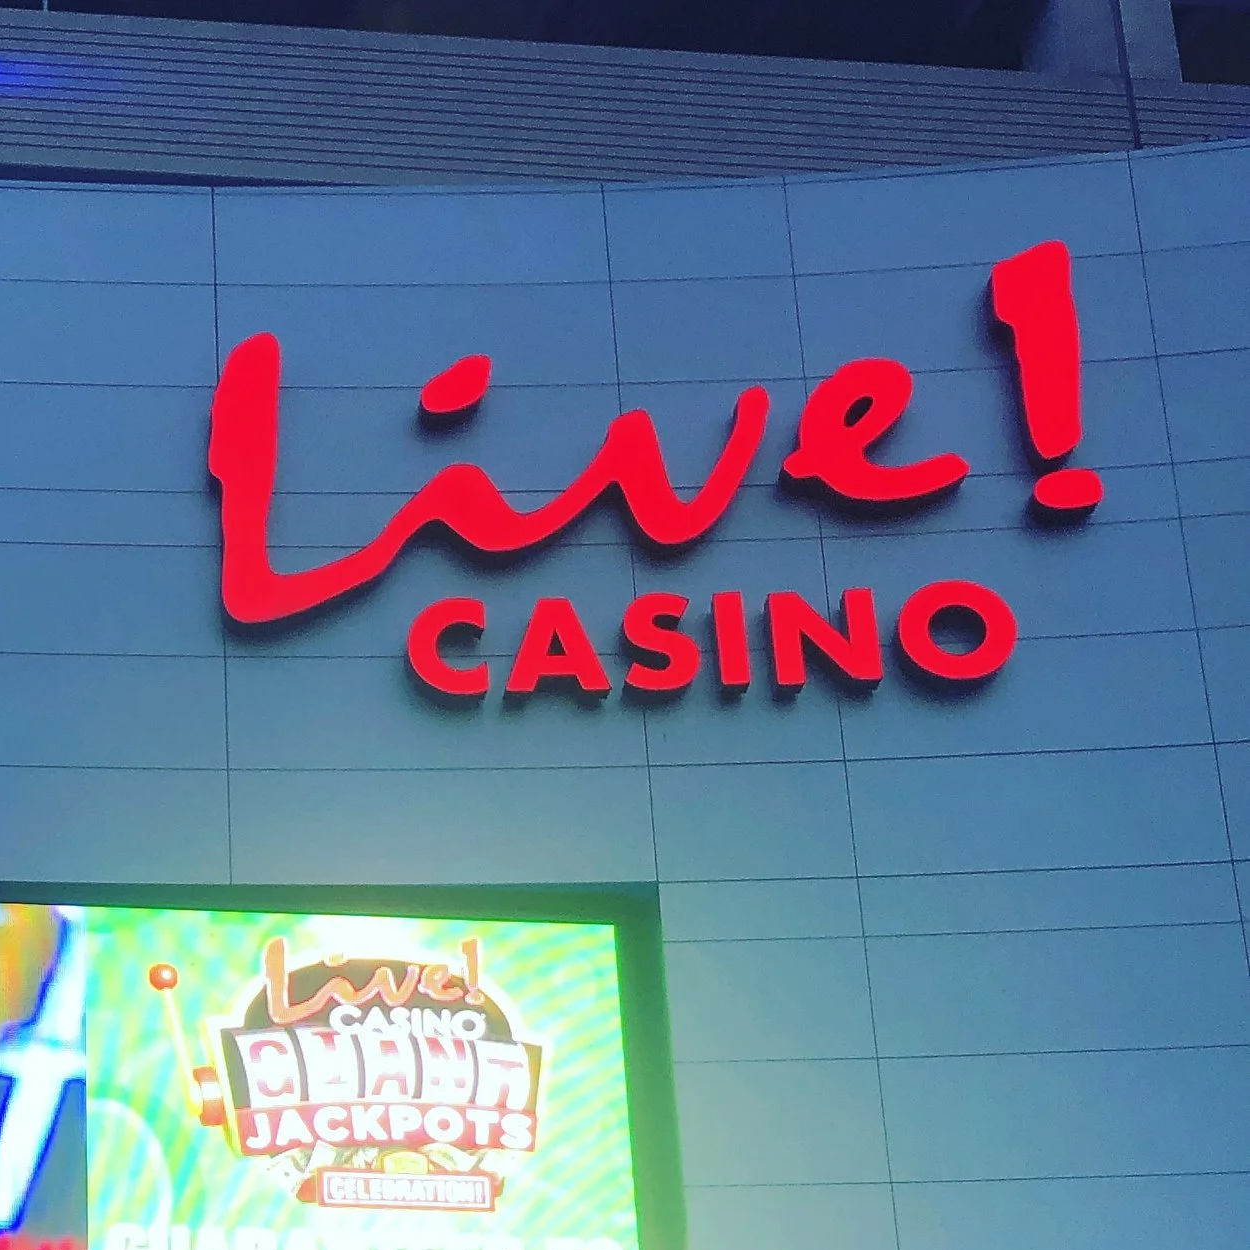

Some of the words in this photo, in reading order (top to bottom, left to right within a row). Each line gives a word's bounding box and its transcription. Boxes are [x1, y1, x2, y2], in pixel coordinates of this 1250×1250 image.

[209, 241, 1103, 624] Live!
[407, 580, 1018, 698] CASINO
[263, 937, 485, 1024] Live!
[329, 1005, 487, 1040] CASINO
[246, 1105, 535, 1151] JACKPOTS
